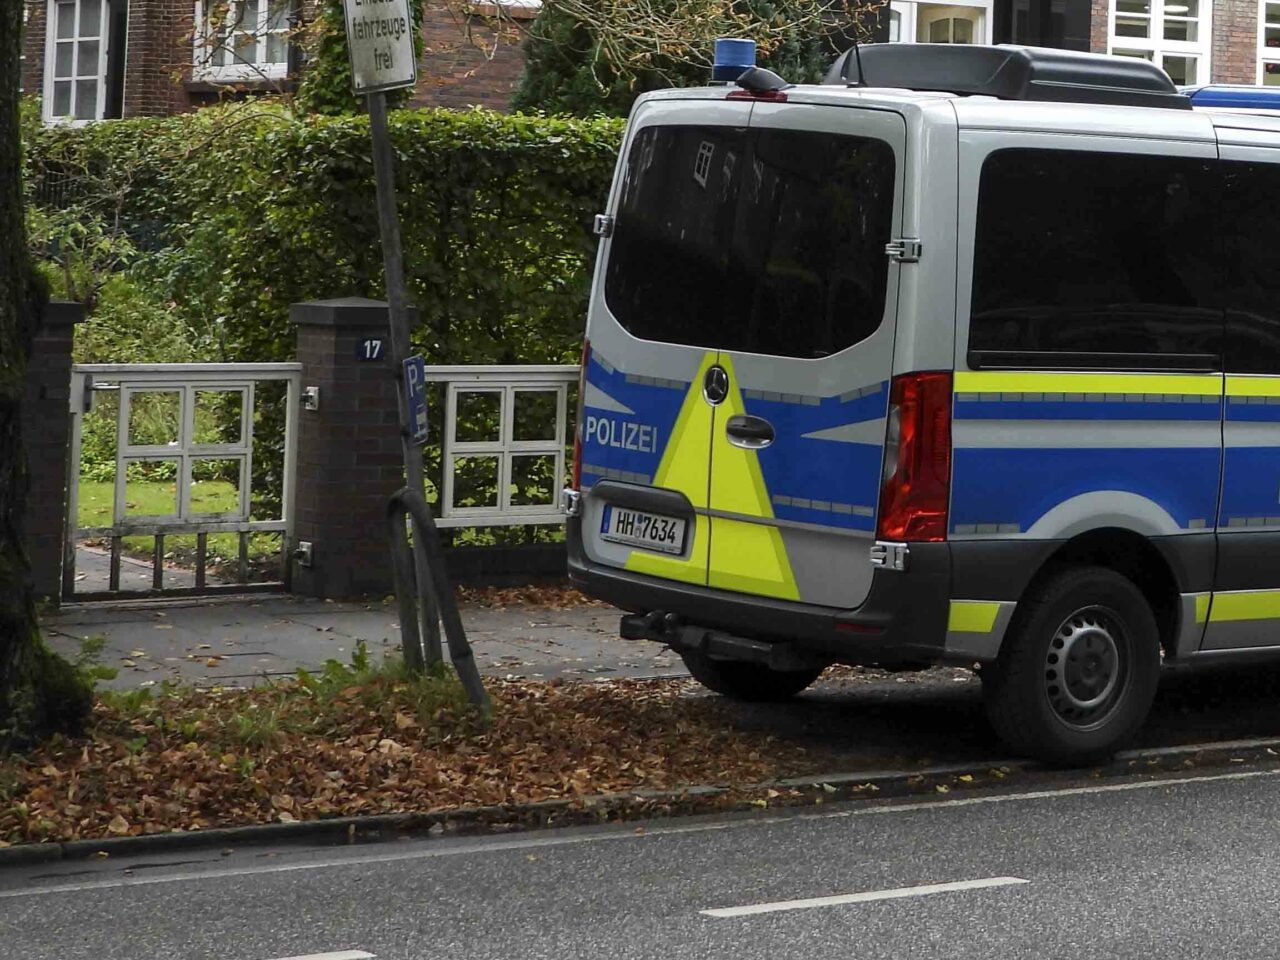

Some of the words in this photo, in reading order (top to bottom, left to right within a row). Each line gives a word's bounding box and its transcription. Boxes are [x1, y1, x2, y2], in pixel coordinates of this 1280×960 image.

[352, 15, 407, 42] fahrzeuge
[373, 45, 394, 71] frei
[363, 339, 382, 359] 17
[585, 415, 658, 454] POLIZEI
[616, 511, 637, 536] HH
[643, 516, 678, 544] 7634
